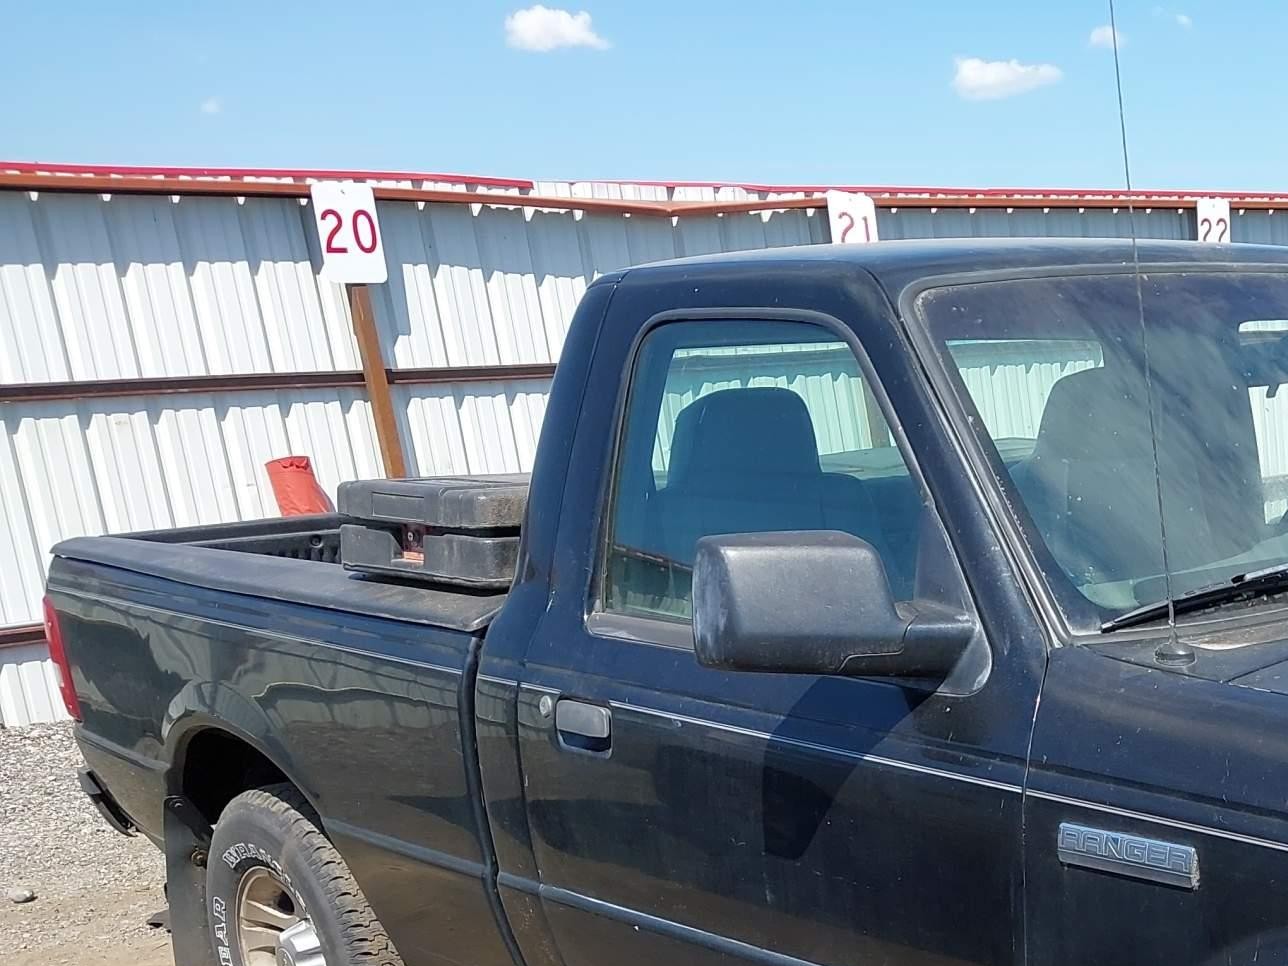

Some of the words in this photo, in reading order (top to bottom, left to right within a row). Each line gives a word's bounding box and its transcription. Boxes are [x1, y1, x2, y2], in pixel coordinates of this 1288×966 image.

[319, 208, 379, 254] 20
[838, 211, 871, 243] 21
[1060, 827, 1190, 873] RANGER
